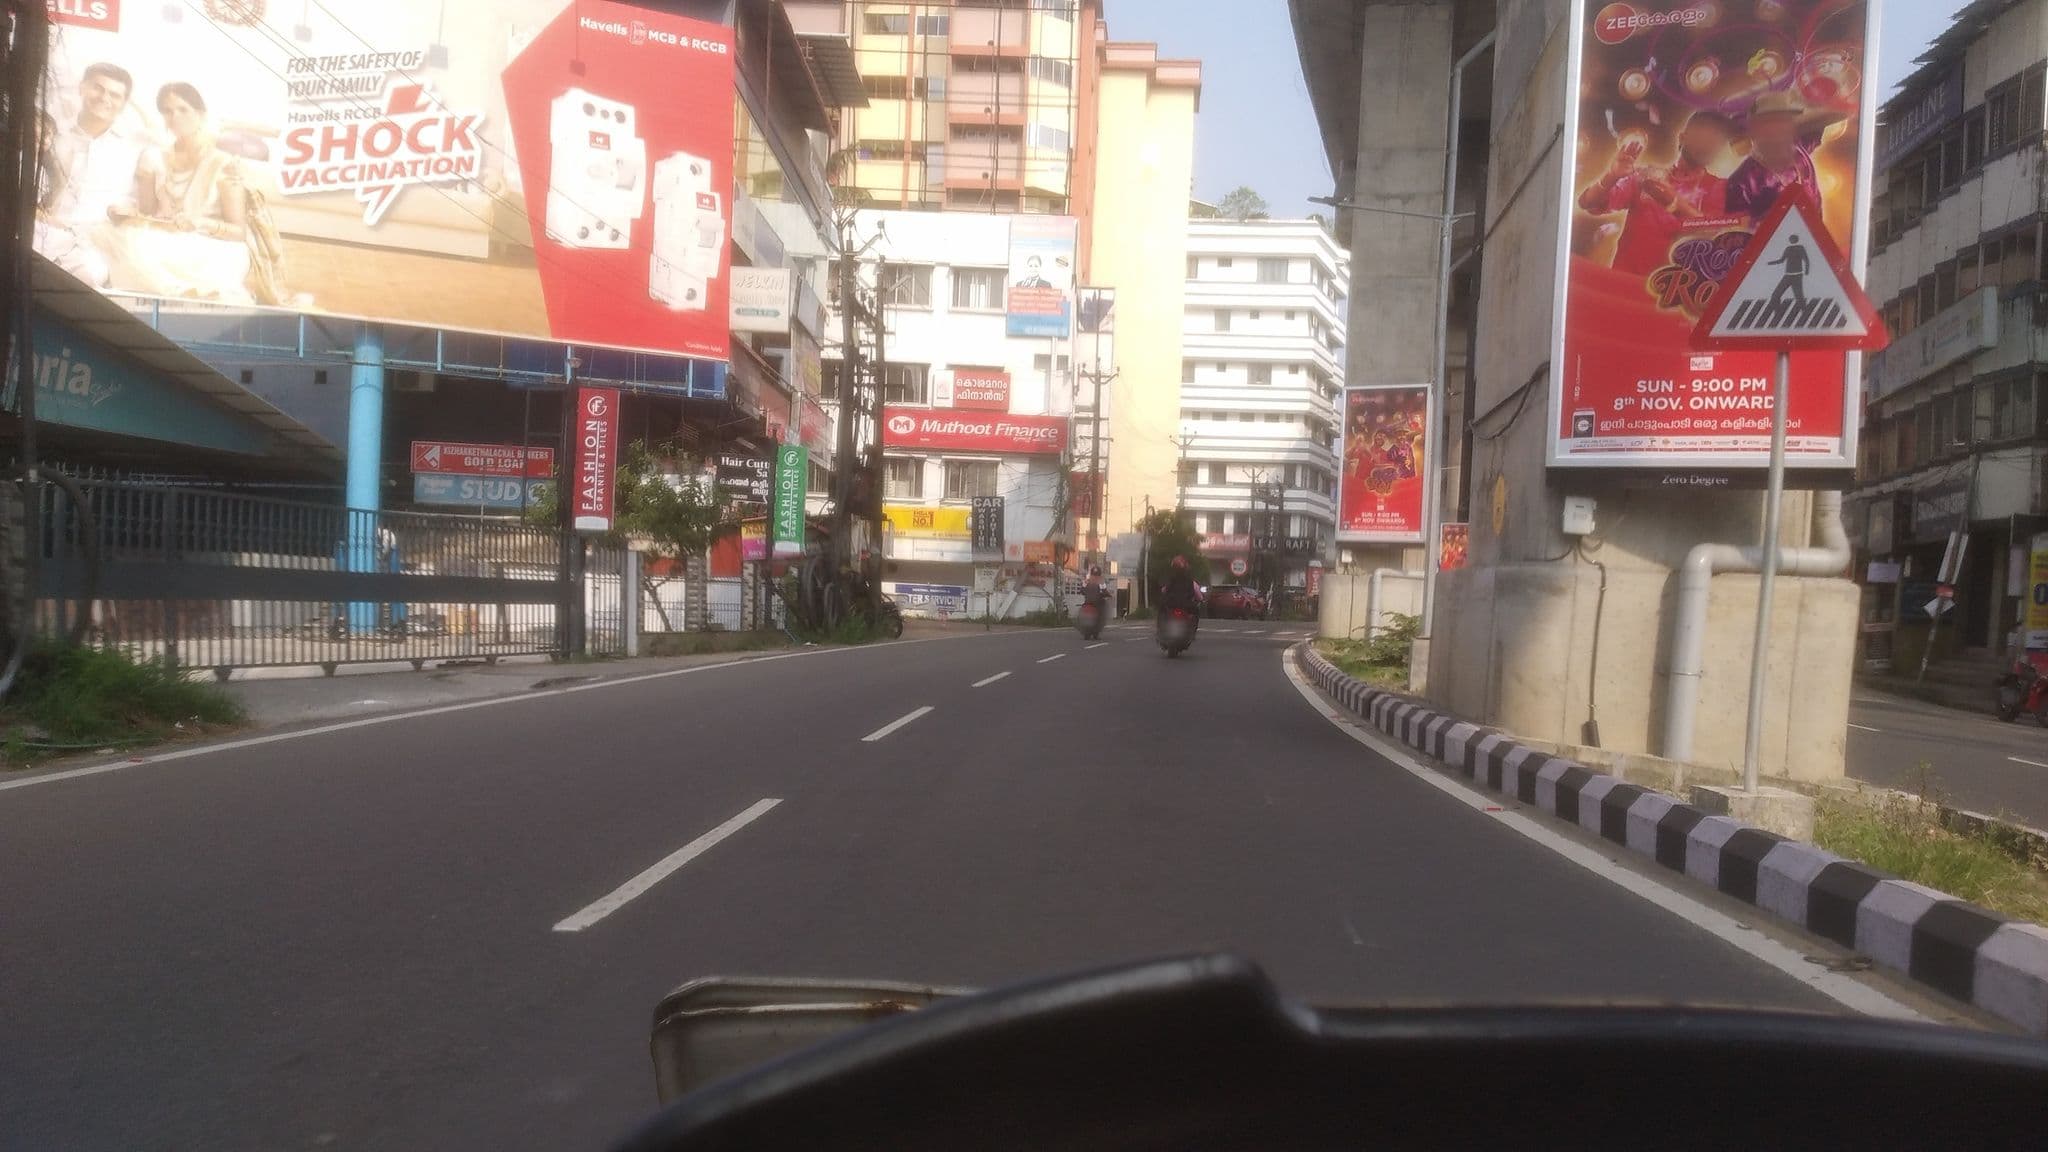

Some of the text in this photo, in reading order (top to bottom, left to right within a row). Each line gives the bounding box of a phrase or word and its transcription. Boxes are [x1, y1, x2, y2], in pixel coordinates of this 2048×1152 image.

[1606, 16, 1637, 30] ZEE
[580, 16, 727, 54] Havells MCB & RCCB
[287, 51, 421, 74] FOR THE SAFETY OF
[286, 75, 382, 97] YOUR FAMILY
[287, 107, 383, 123] Havells RCCB
[283, 115, 477, 165] SHOCK
[281, 156, 475, 188] VACCINATION
[33, 346, 92, 397] ria
[1637, 380, 1673, 393] SUN
[1692, 379, 1734, 393] 9:00
[1740, 378, 1766, 392] PM
[1613, 396, 1775, 411] 8th NOV. ONWARD
[599, 421, 607, 449] TILES
[921, 419, 1059, 439] Muthoot Finance
[1600, 418, 1625, 431] ഇനി
[1693, 419, 1718, 431] ഒരു
[582, 420, 597, 511] FASHION
[721, 457, 744, 467] Hair
[460, 479, 548, 501] STUDO
[597, 463, 606, 511] GRANITE
[1661, 474, 1729, 488] Zero Degree
[780, 469, 792, 537] FASHION
[973, 497, 1002, 508] CAR
